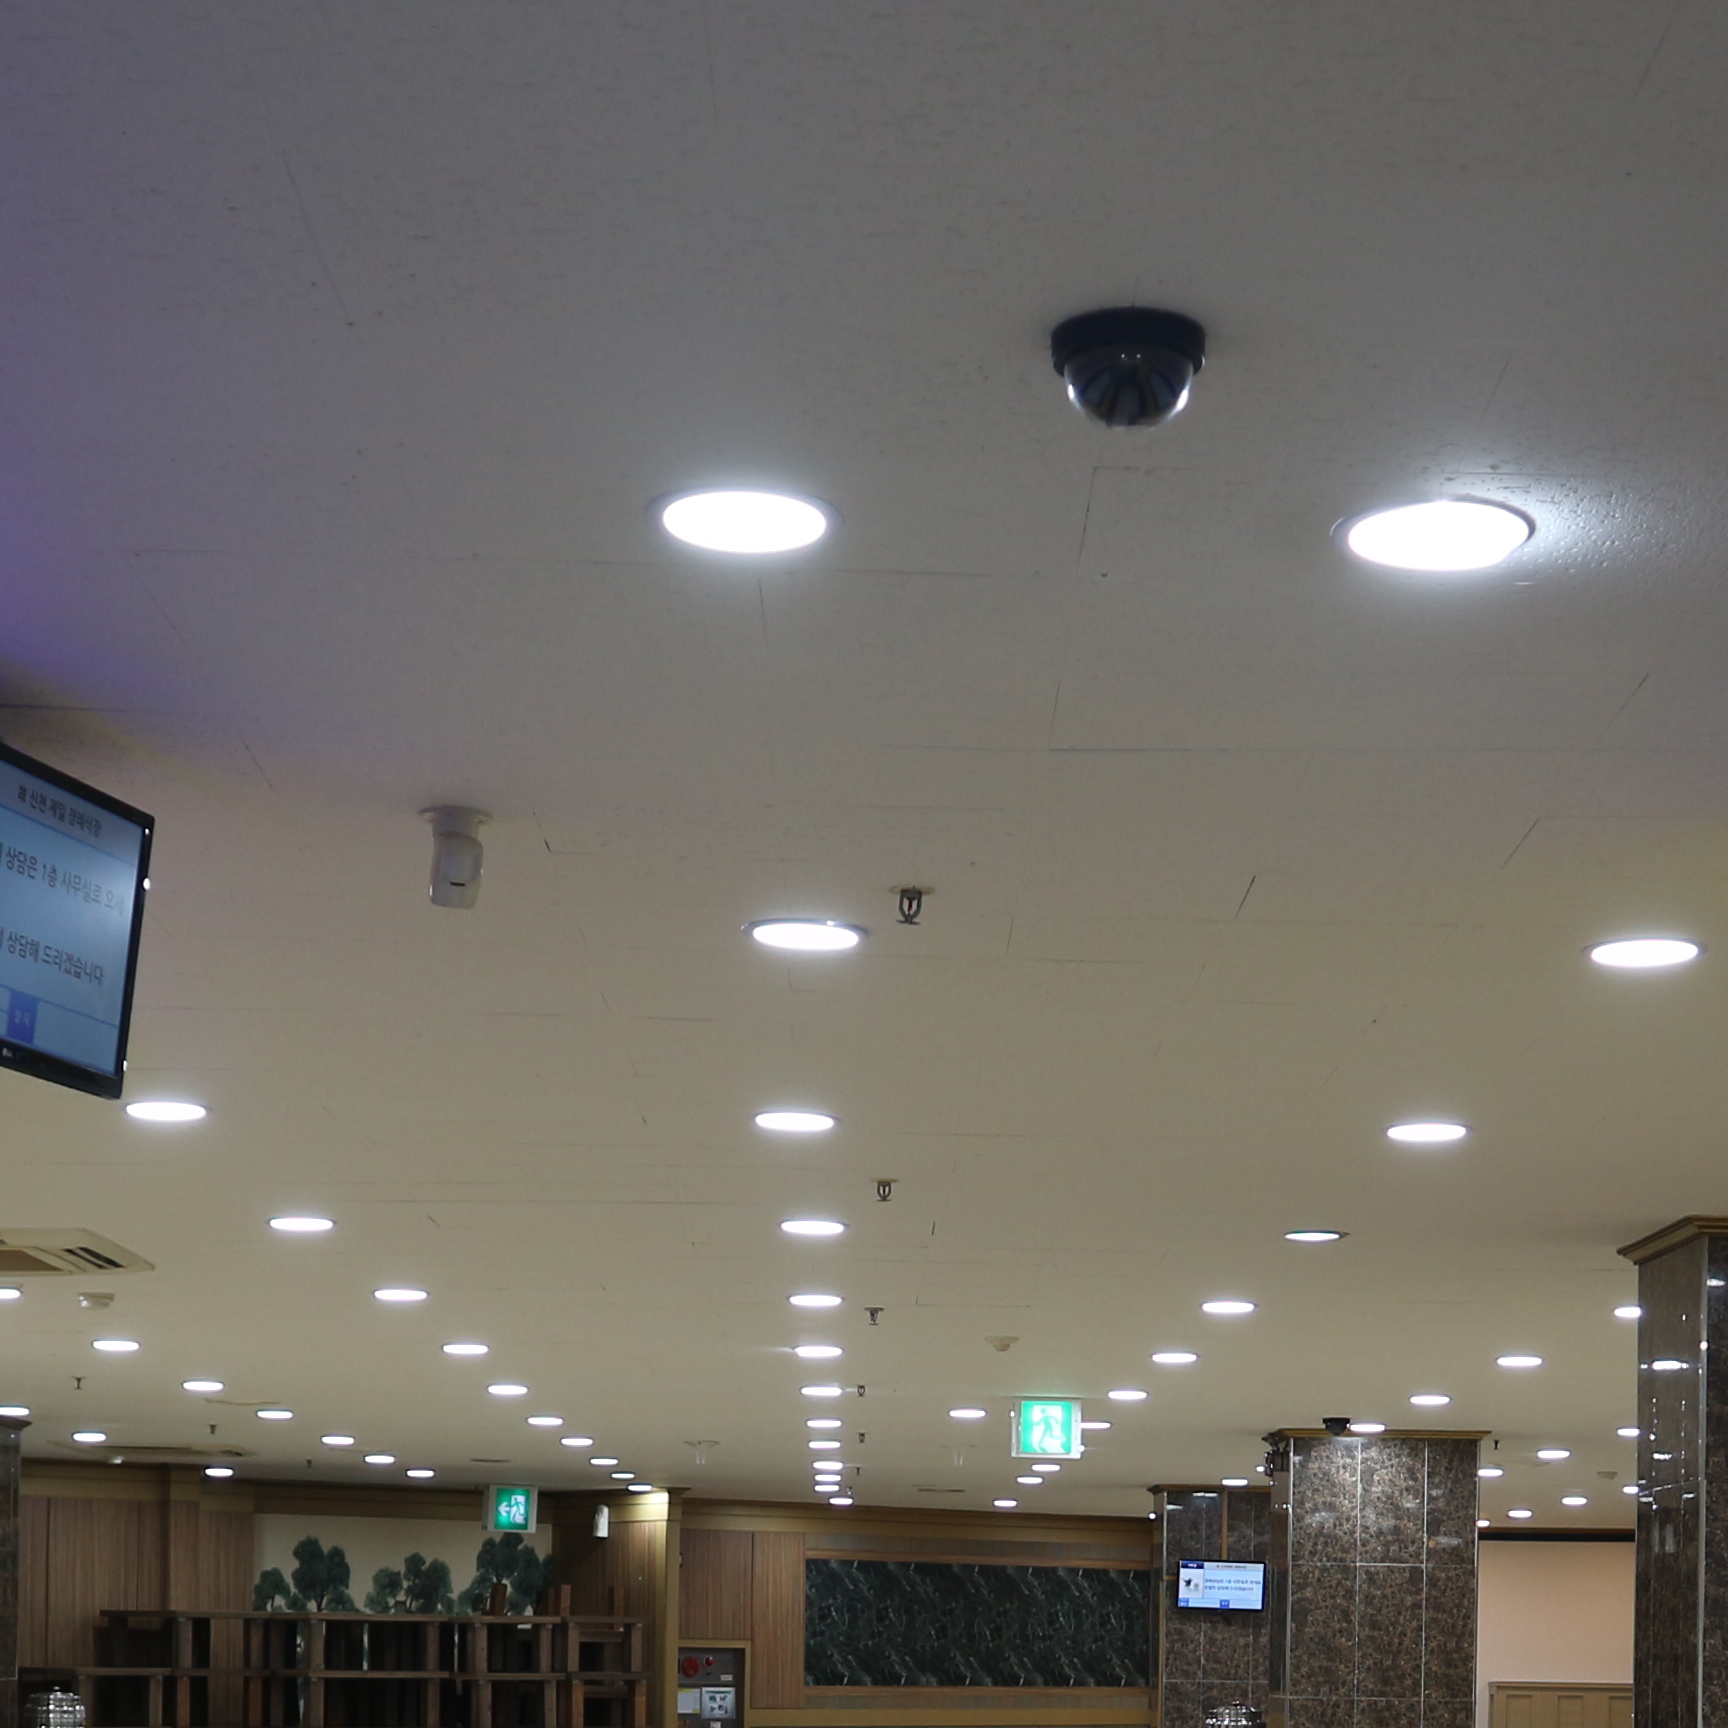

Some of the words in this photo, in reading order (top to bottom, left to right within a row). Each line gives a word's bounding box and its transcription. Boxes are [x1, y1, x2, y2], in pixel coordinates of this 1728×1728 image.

[6, 846, 38, 880] 상담은
[41, 859, 58, 889] 1층
[61, 870, 102, 907] 사무실로
[7, 931, 40, 963] 상담해
[41, 945, 103, 988] 드리겠습니다
